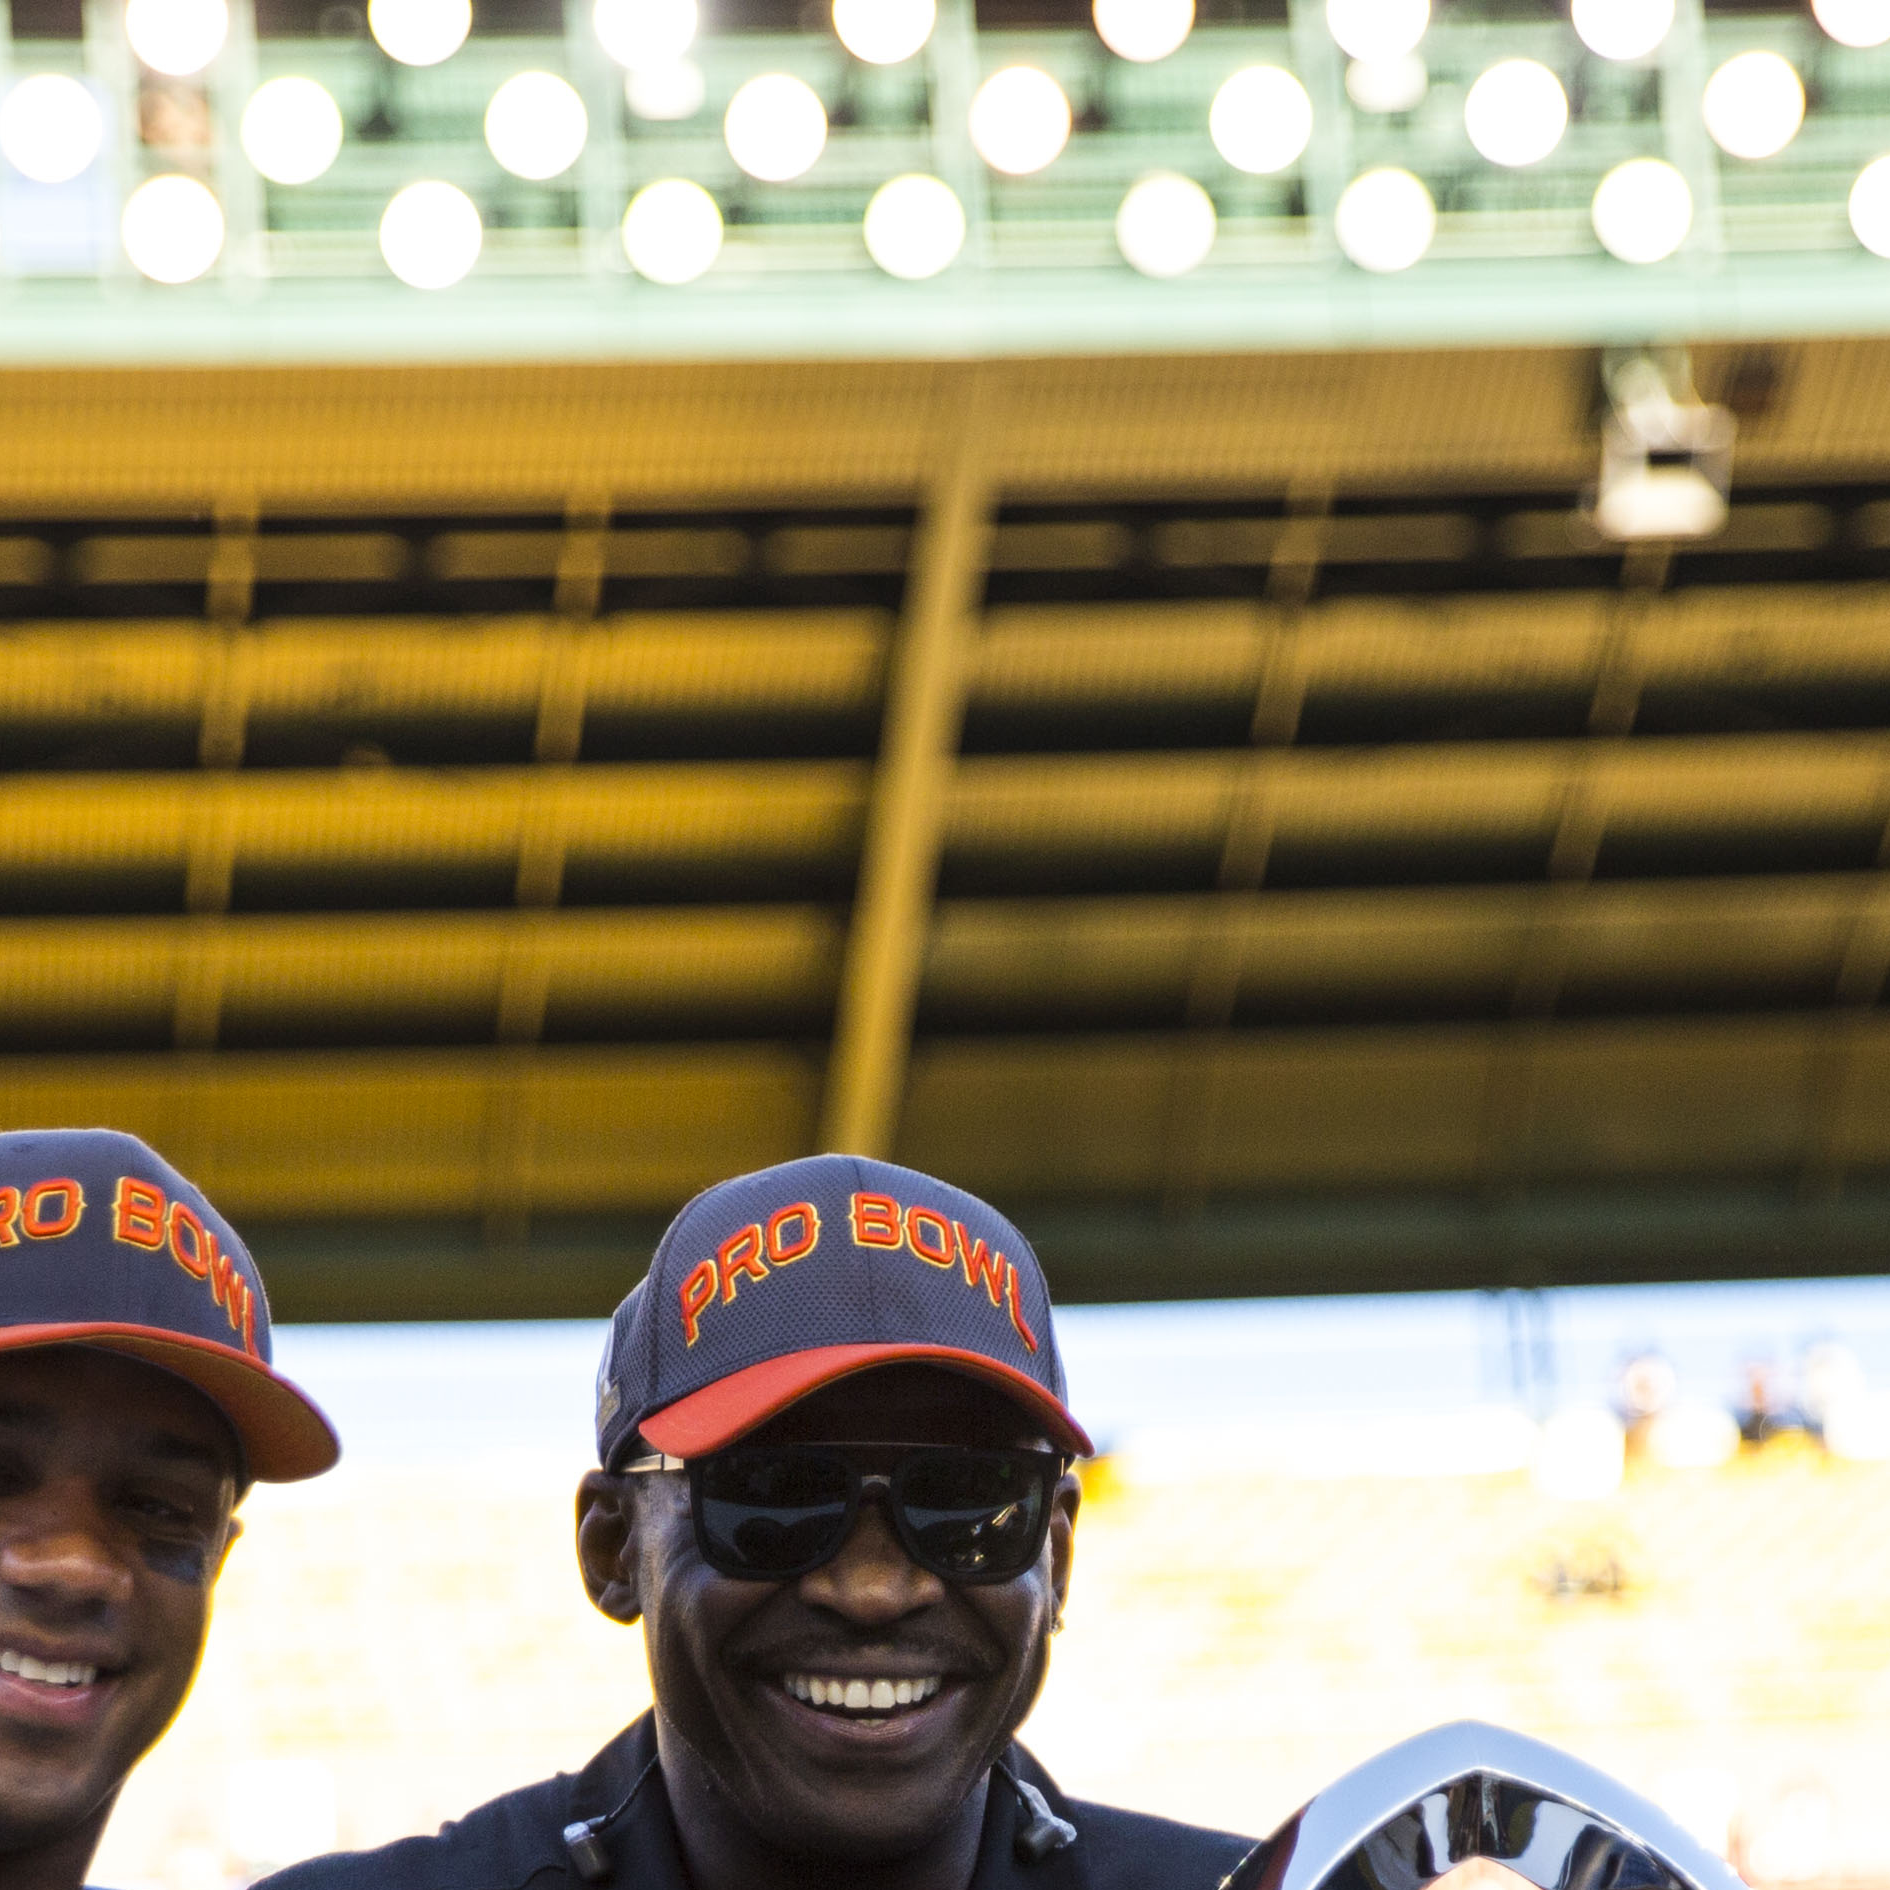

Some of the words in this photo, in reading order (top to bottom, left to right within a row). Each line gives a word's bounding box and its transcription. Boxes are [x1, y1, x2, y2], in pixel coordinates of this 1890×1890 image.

[111, 1176, 259, 1358] BOWL
[679, 1202, 822, 1348] PRO
[849, 1192, 1038, 1353] BOWL
